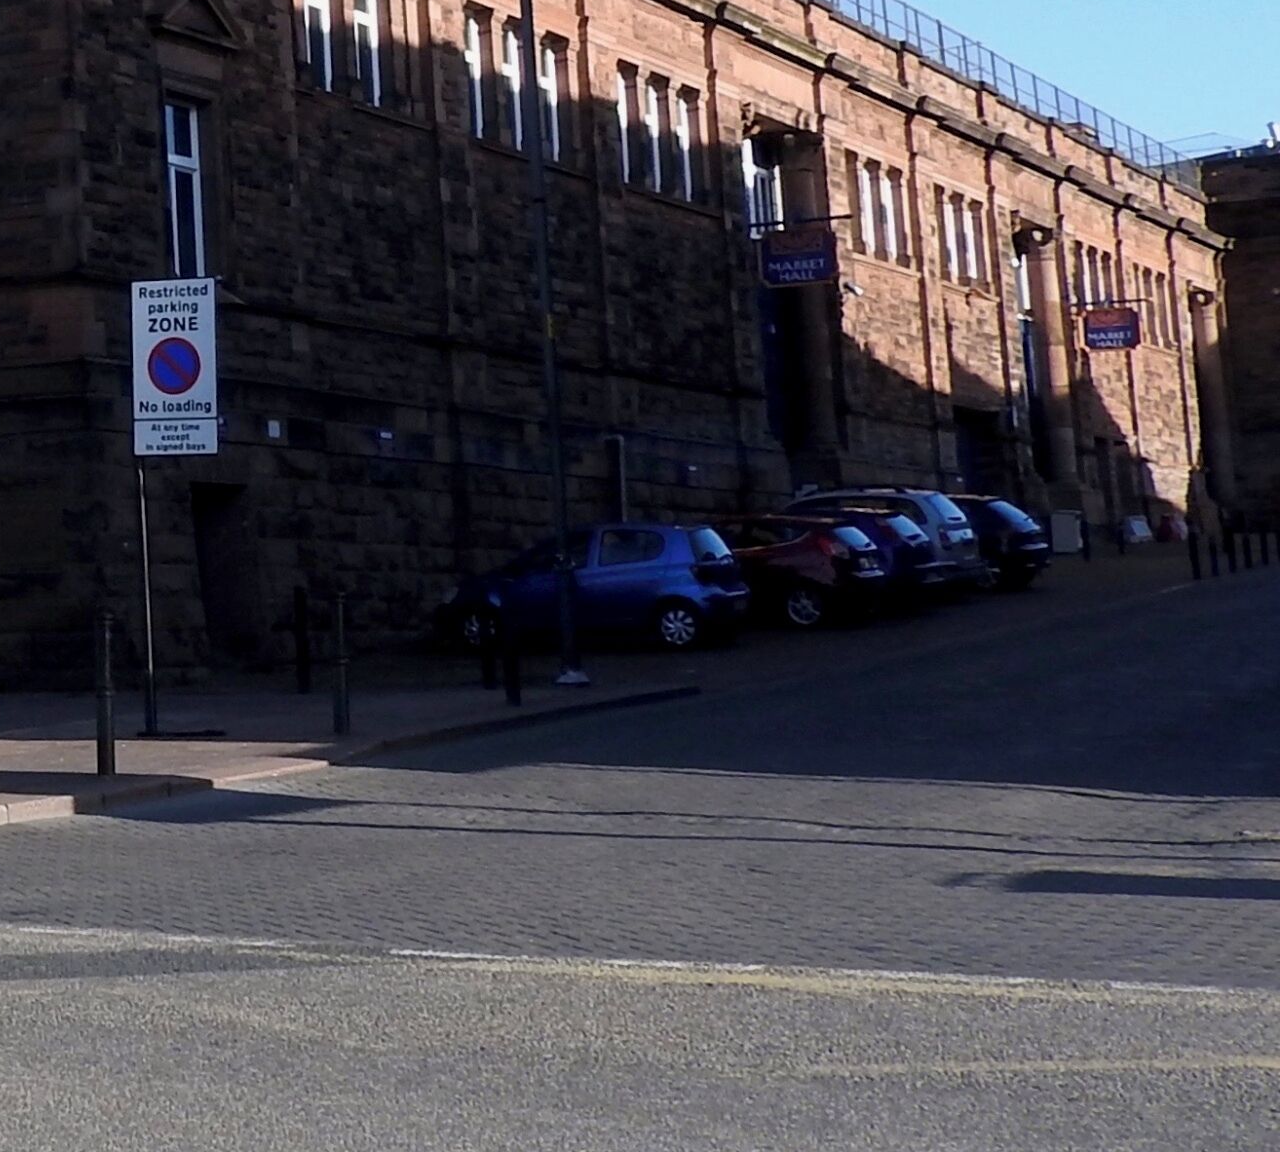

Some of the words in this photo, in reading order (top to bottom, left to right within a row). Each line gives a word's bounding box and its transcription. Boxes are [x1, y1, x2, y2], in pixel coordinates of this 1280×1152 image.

[768, 259, 824, 271] MARKET
[779, 270, 815, 281] HALL
[139, 284, 208, 298] Restricted
[148, 301, 199, 315] parking
[148, 317, 199, 332] ZONE
[139, 400, 158, 413] No
[162, 399, 212, 414] loading
[164, 424, 178, 432] any
[161, 433, 190, 442] except
[156, 442, 183, 451] signed
[186, 442, 206, 450] bays
